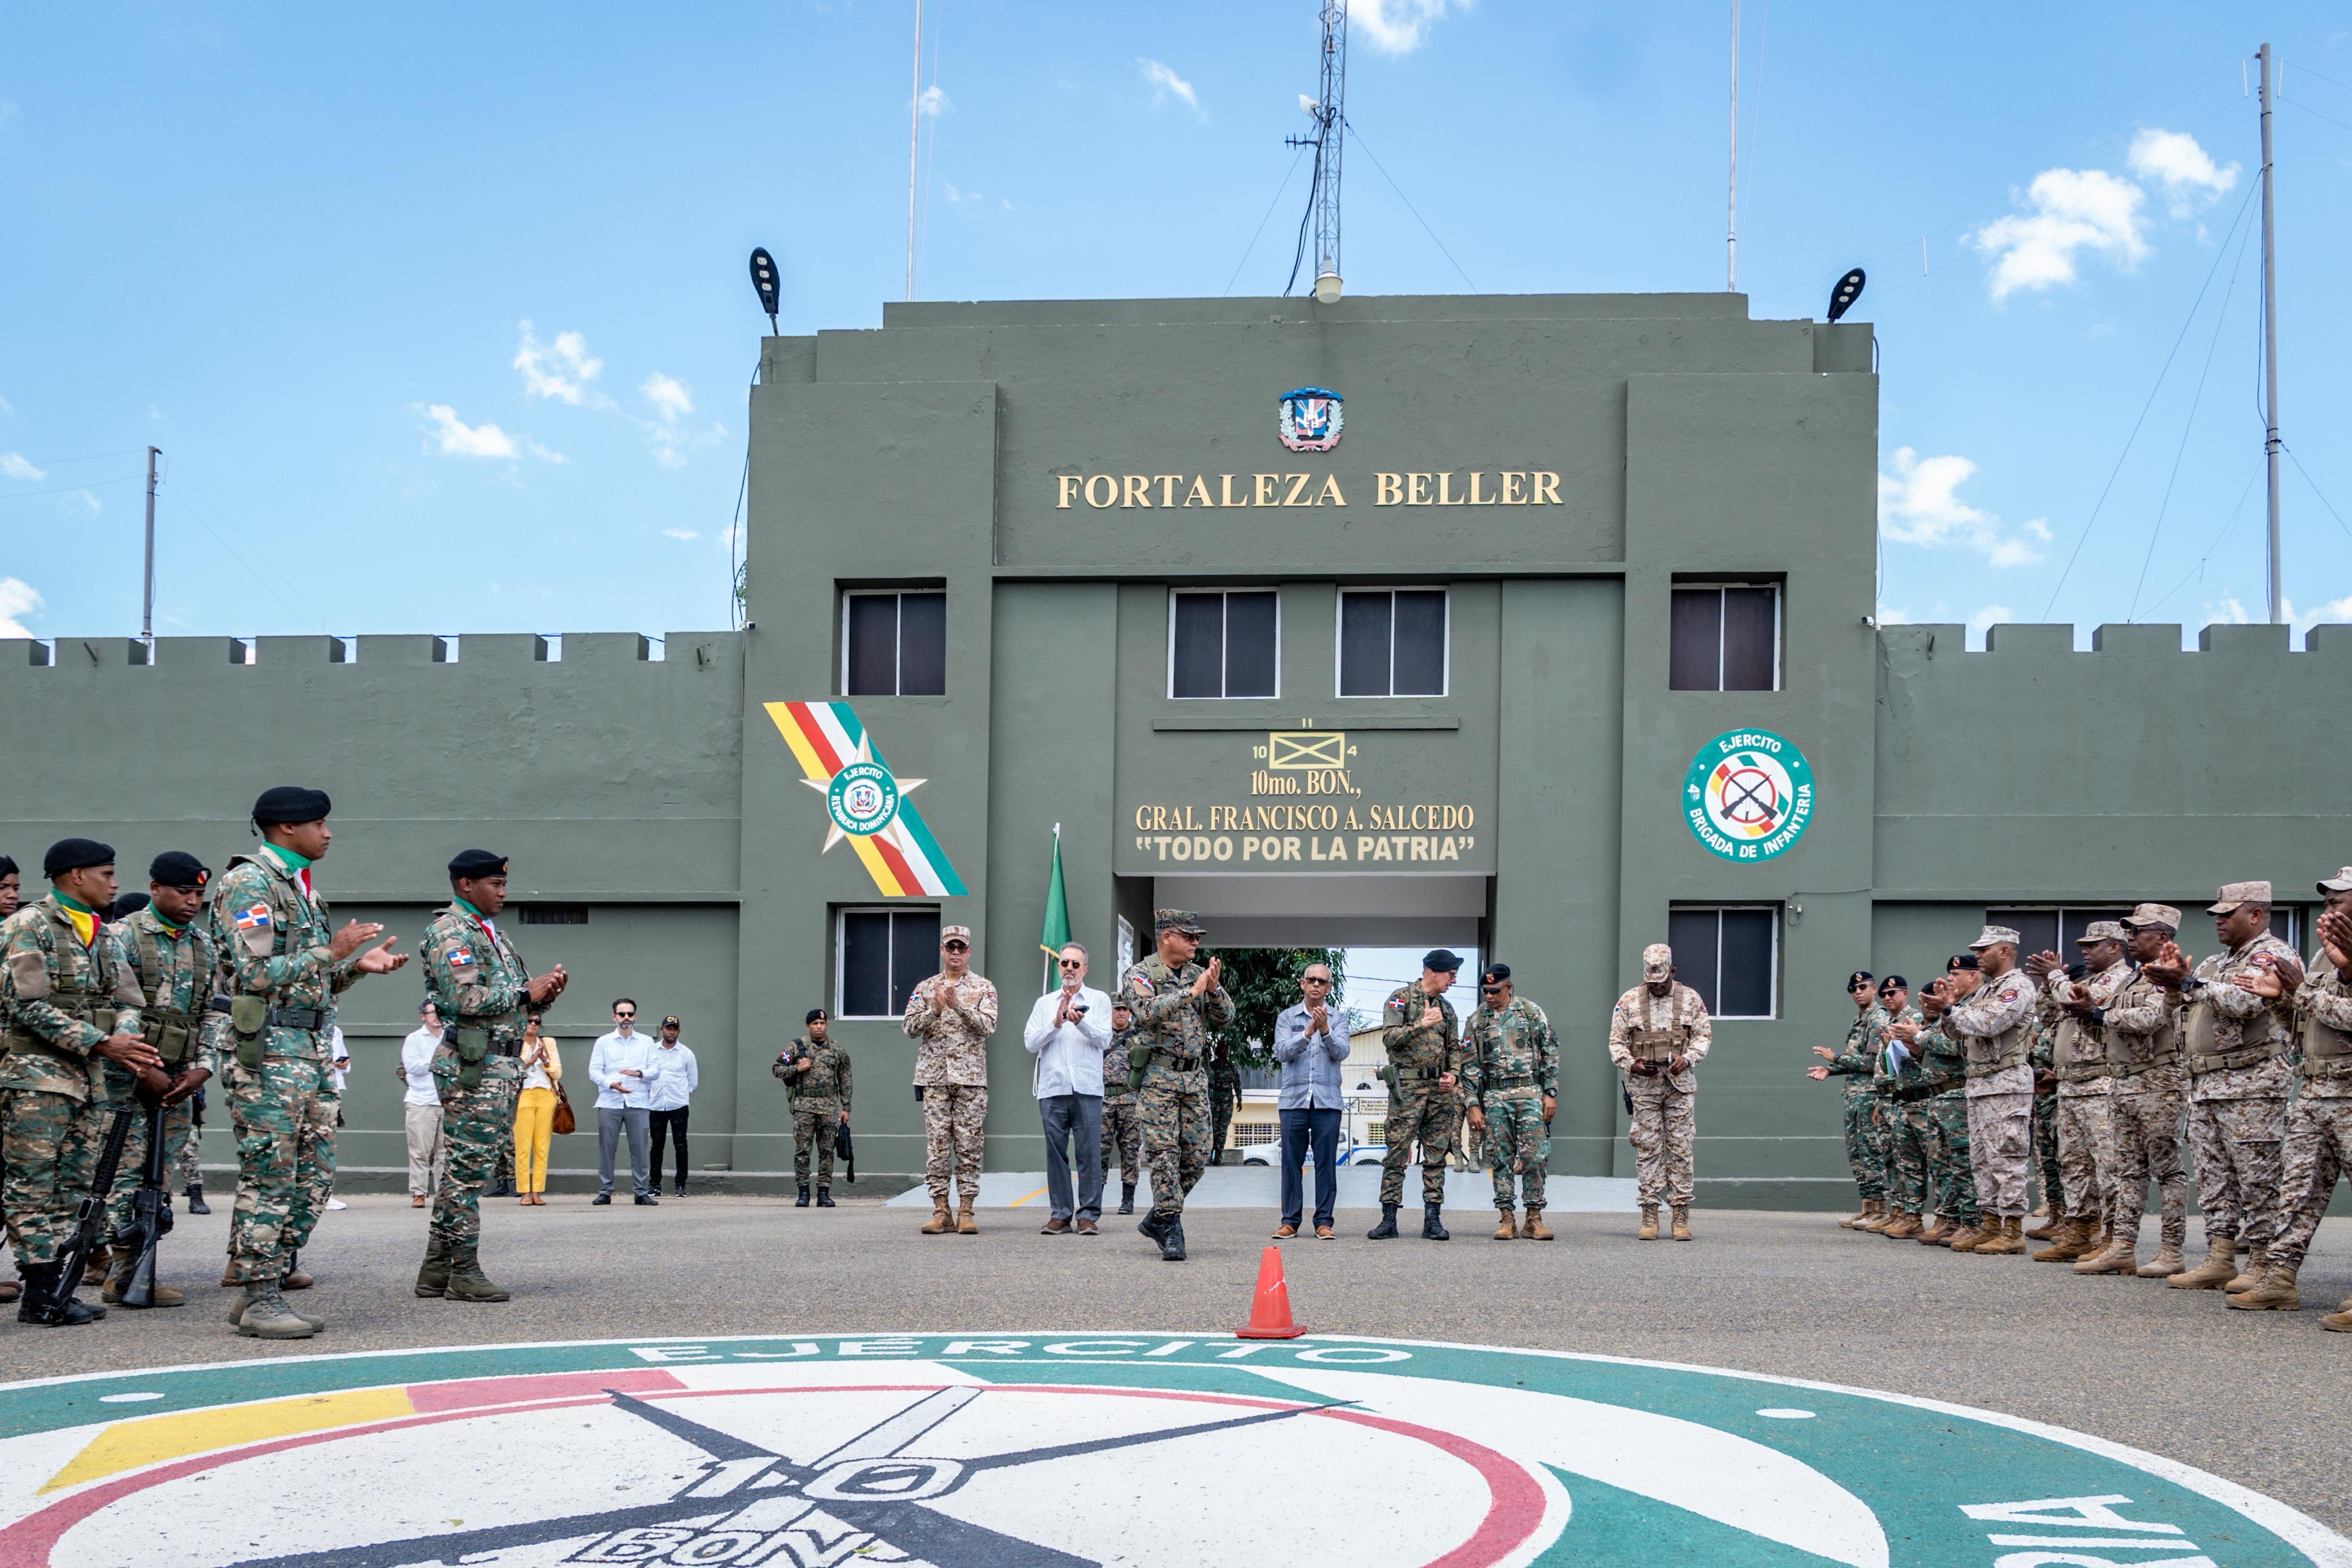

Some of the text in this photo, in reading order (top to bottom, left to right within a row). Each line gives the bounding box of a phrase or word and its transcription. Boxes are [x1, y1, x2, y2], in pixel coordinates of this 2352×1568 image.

[1055, 471, 1564, 509] FORTALEZA BELLER
[1252, 745, 1268, 759] 10
[1346, 745, 1357, 756] 4
[1719, 734, 1781, 753] EJERCITO
[843, 766, 883, 781] EJERCITO
[1251, 769, 1361, 800] 10mo. BON.,
[831, 793, 895, 831] REPUBLICA DOMINICANA
[1136, 804, 1474, 831] GRAL. FRANCISCO A. SALCEDO
[1689, 808, 1733, 856] BRIGADA
[1739, 845, 1757, 858] DE
[1763, 783, 1811, 855] INFANTERIA
[1243, 836, 1302, 861] POR
[1311, 836, 1348, 860] LA
